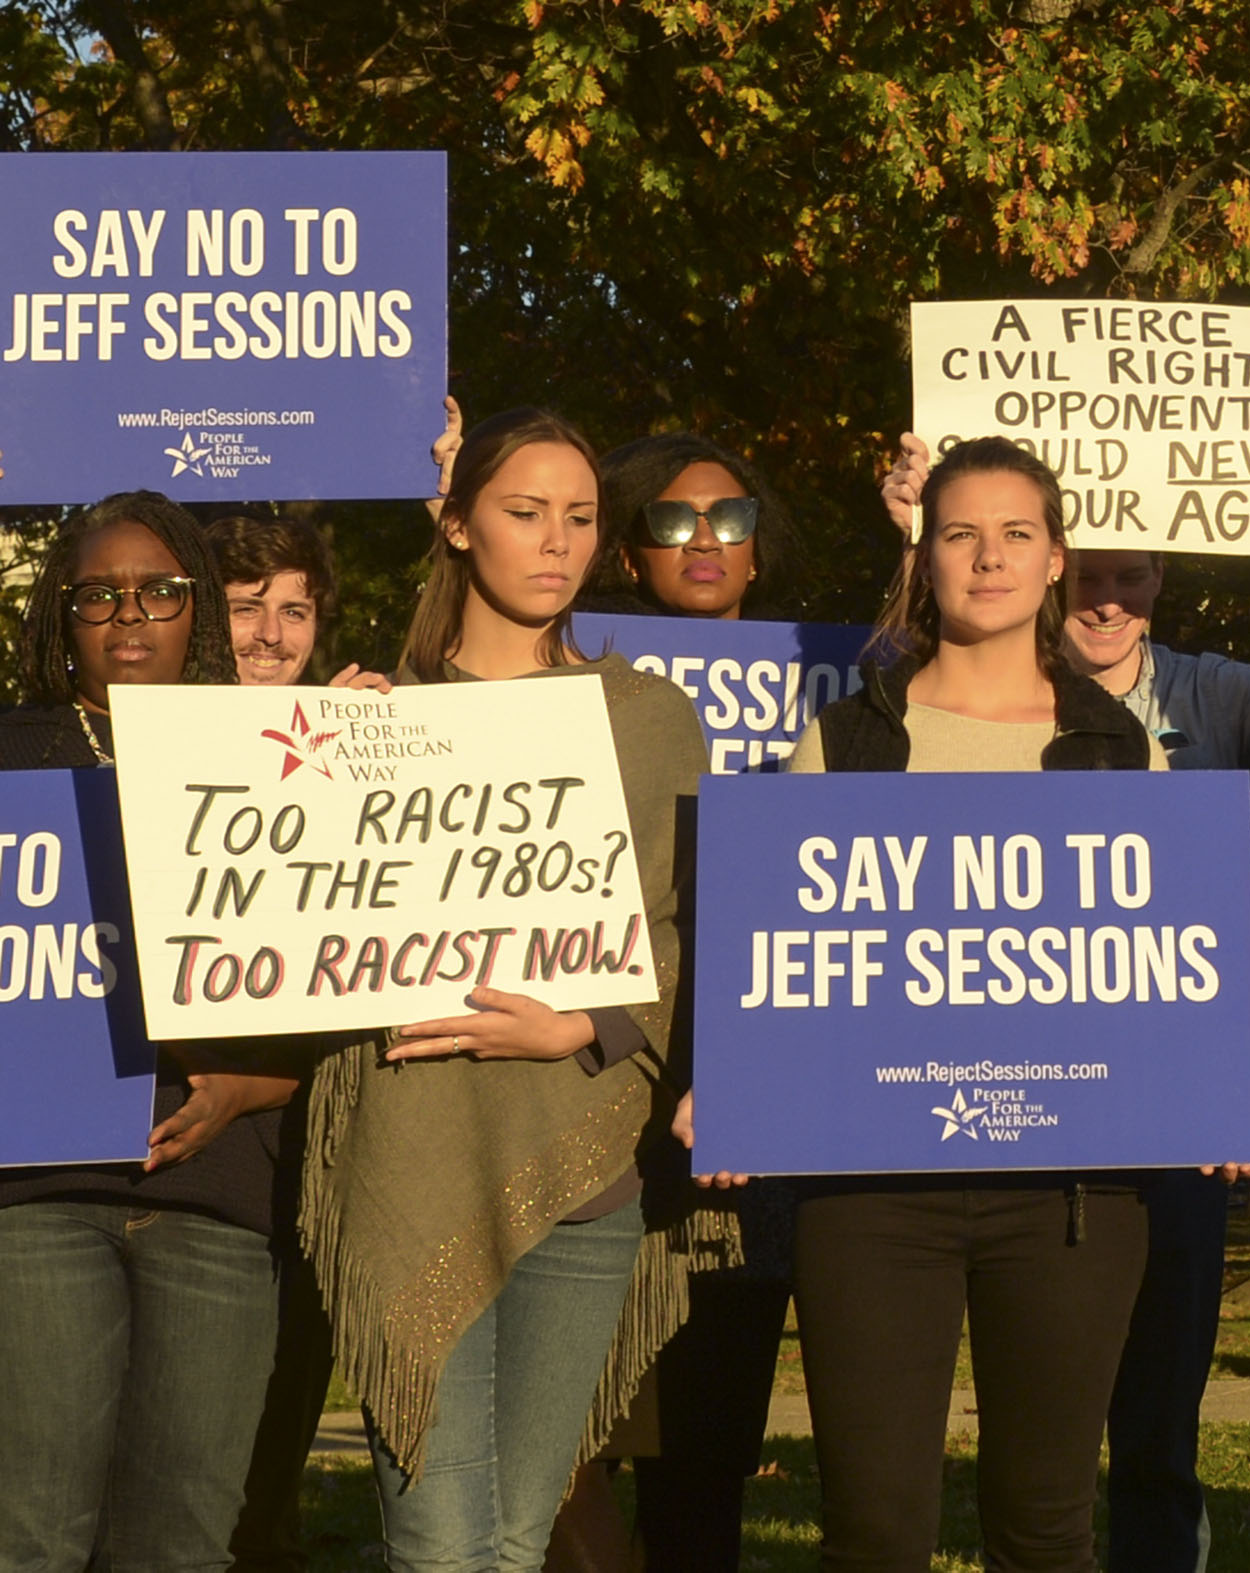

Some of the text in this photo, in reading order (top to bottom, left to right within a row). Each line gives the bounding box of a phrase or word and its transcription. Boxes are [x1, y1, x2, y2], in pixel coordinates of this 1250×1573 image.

[52, 207, 358, 279] SAY NO TO
[3, 289, 412, 362] JEFF SESSIONS
[992, 305, 1232, 347] A FIERCE
[942, 347, 1070, 382] CIVIL
[118, 407, 315, 431] www.RejectSessions.com
[937, 435, 1128, 481] ULD
[1167, 490, 1250, 542] AG
[320, 700, 397, 719] PEOPLE
[334, 740, 453, 760] AMERICAN
[348, 764, 398, 782] WAY
[185, 778, 585, 856] TOO RACIST
[185, 830, 628, 919] IN THE 1980s?
[797, 833, 1152, 913] SAY NO TO
[166, 935, 285, 1005] TOO
[307, 926, 516, 996] RACIST
[740, 924, 1220, 1009] JEFF SESSIONS
[876, 1060, 1108, 1087] www.RejectSessions.com
